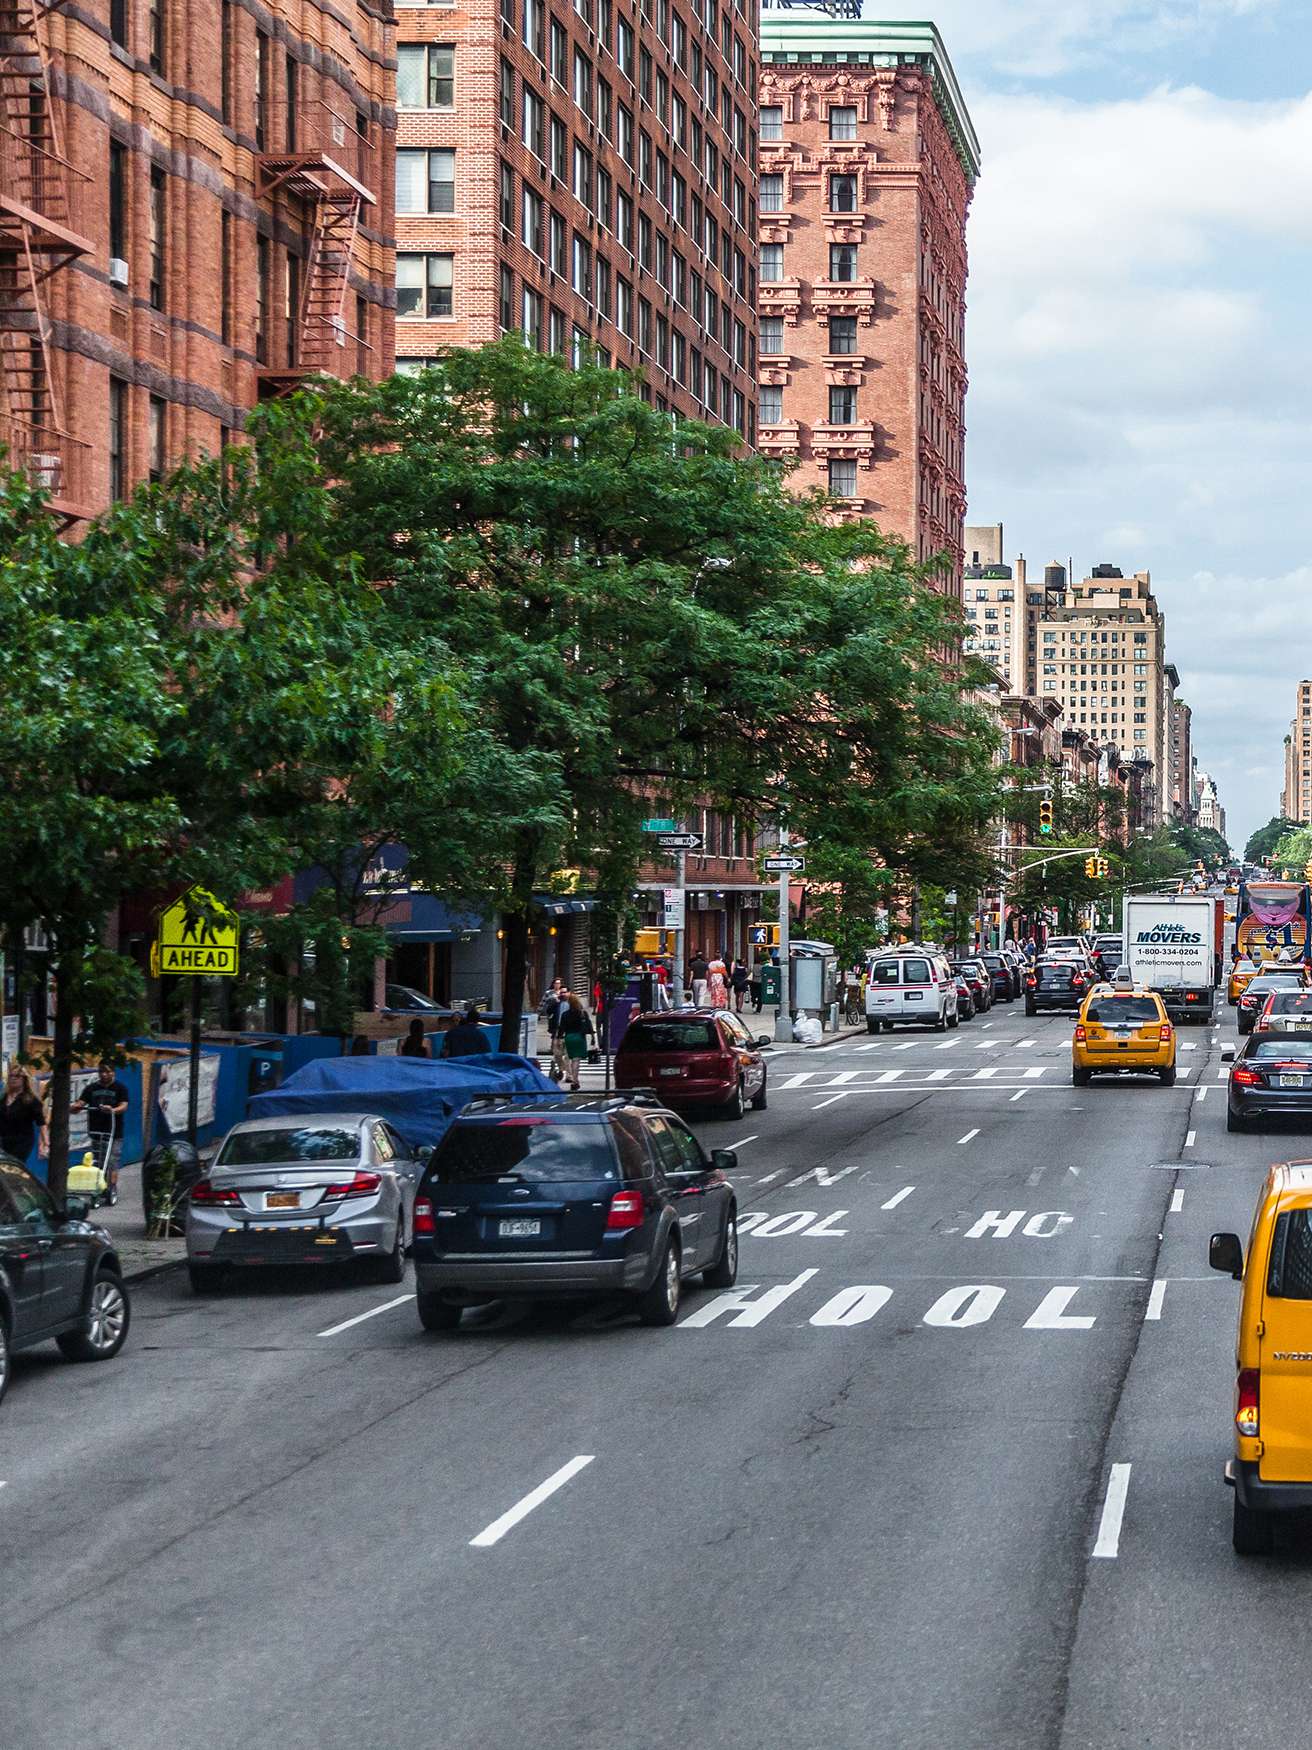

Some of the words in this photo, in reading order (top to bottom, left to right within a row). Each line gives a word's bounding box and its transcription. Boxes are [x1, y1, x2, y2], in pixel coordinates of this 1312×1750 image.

[682, 837, 696, 845] WAY
[1137, 931, 1201, 943] MOVERS
[1138, 948, 1199, 956] 1-800-334-0204
[168, 950, 229, 967] AHEAD
[1135, 959, 1203, 967] athleticmovers.com
